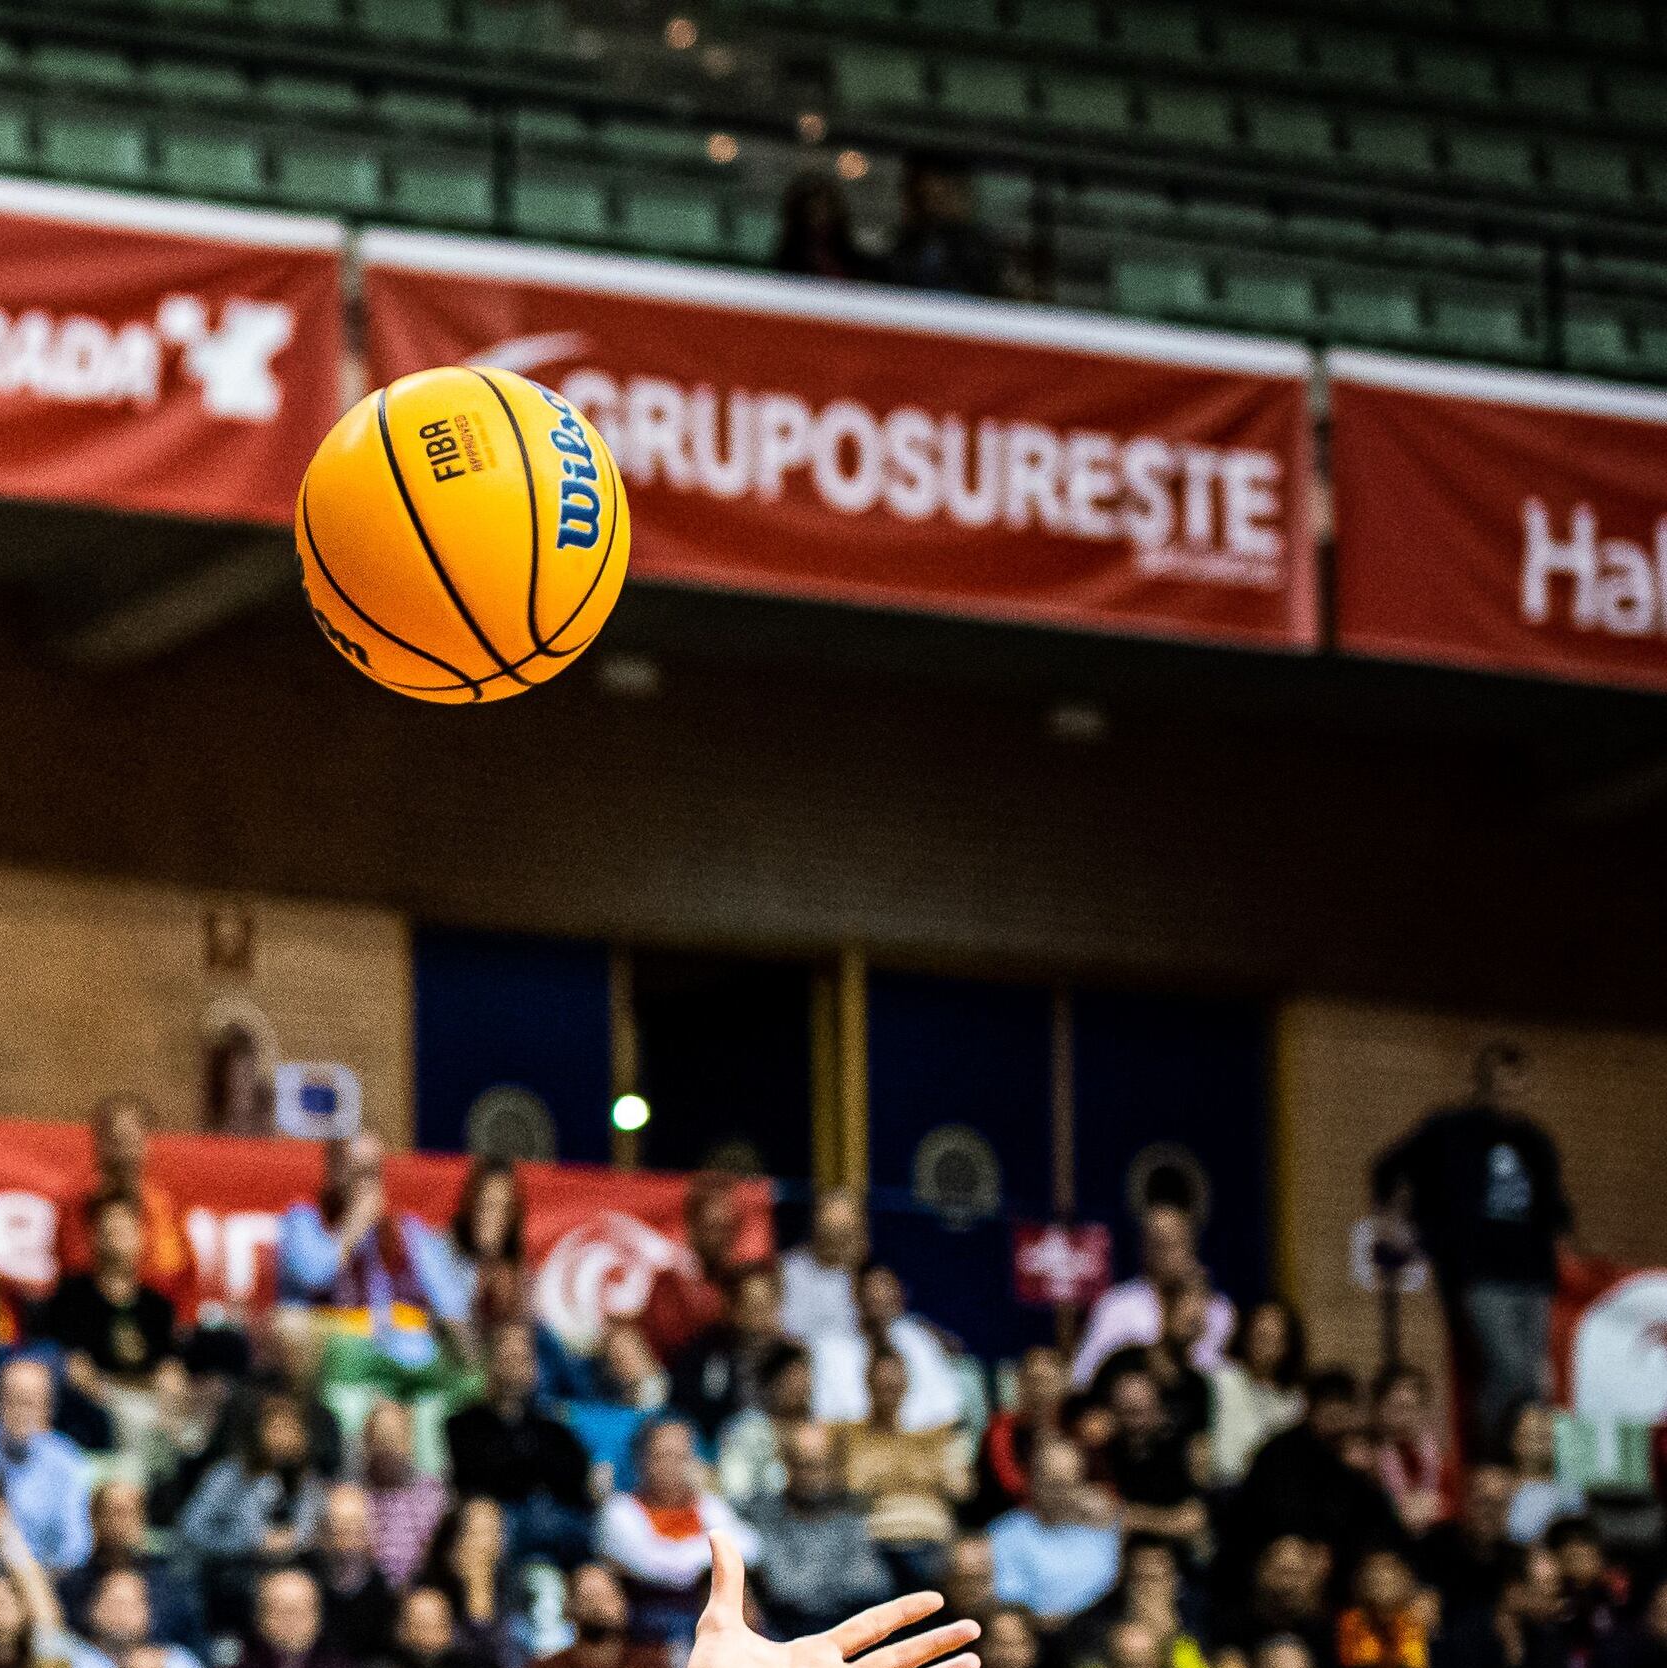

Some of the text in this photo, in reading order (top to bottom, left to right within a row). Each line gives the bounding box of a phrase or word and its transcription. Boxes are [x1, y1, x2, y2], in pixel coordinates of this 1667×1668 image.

[419, 415, 466, 483] FIBA
[528, 378, 603, 552] Wilso
[563, 366, 1289, 560] GRUPOSURESTE
